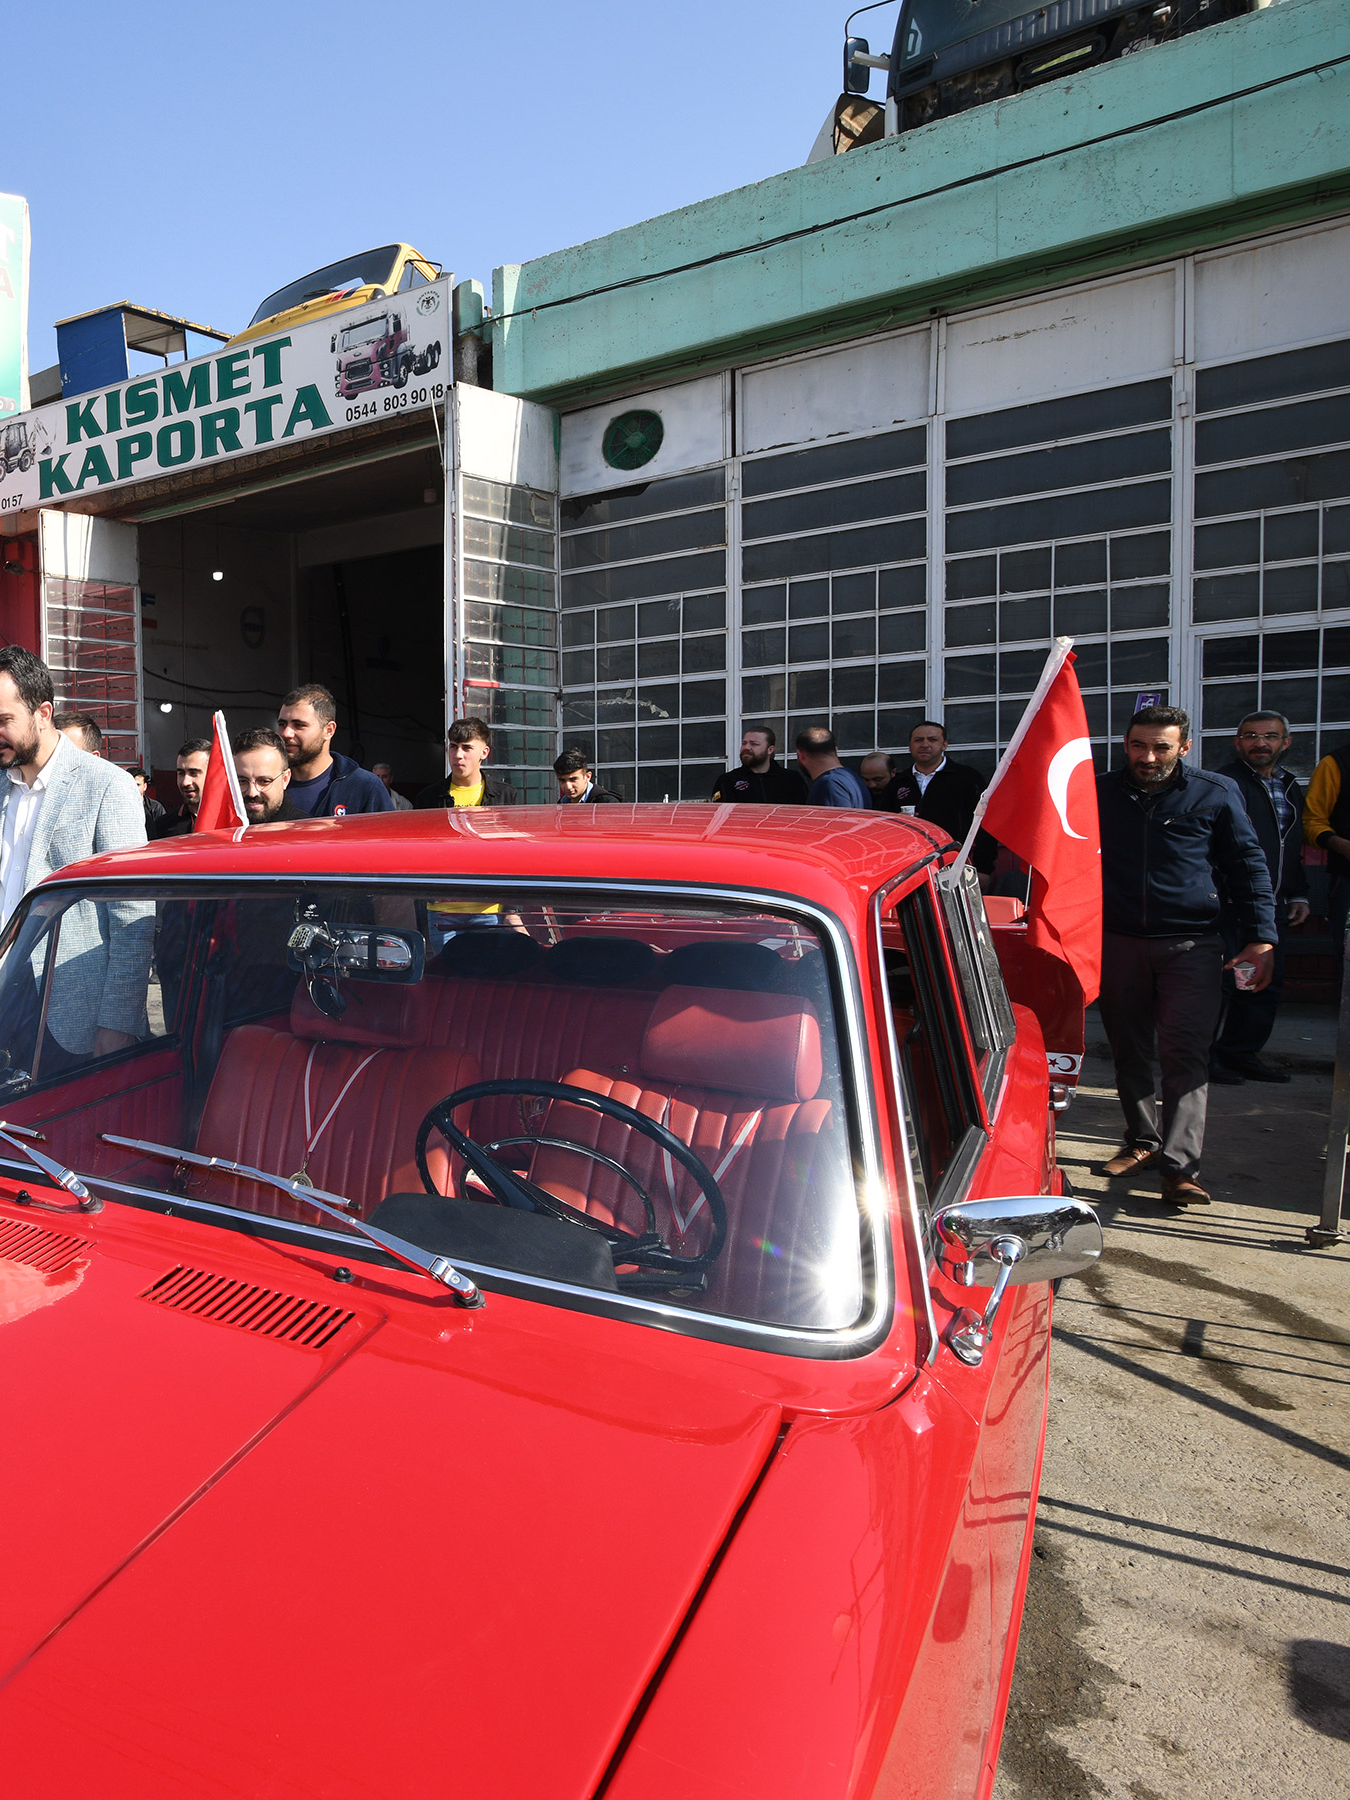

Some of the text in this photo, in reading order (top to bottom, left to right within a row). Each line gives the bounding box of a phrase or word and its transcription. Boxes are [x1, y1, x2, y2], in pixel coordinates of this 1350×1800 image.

[38, 384, 334, 500] KAPORTA
[66, 336, 292, 445] KISMET
[345, 383, 444, 422] 0544 803 90 18
